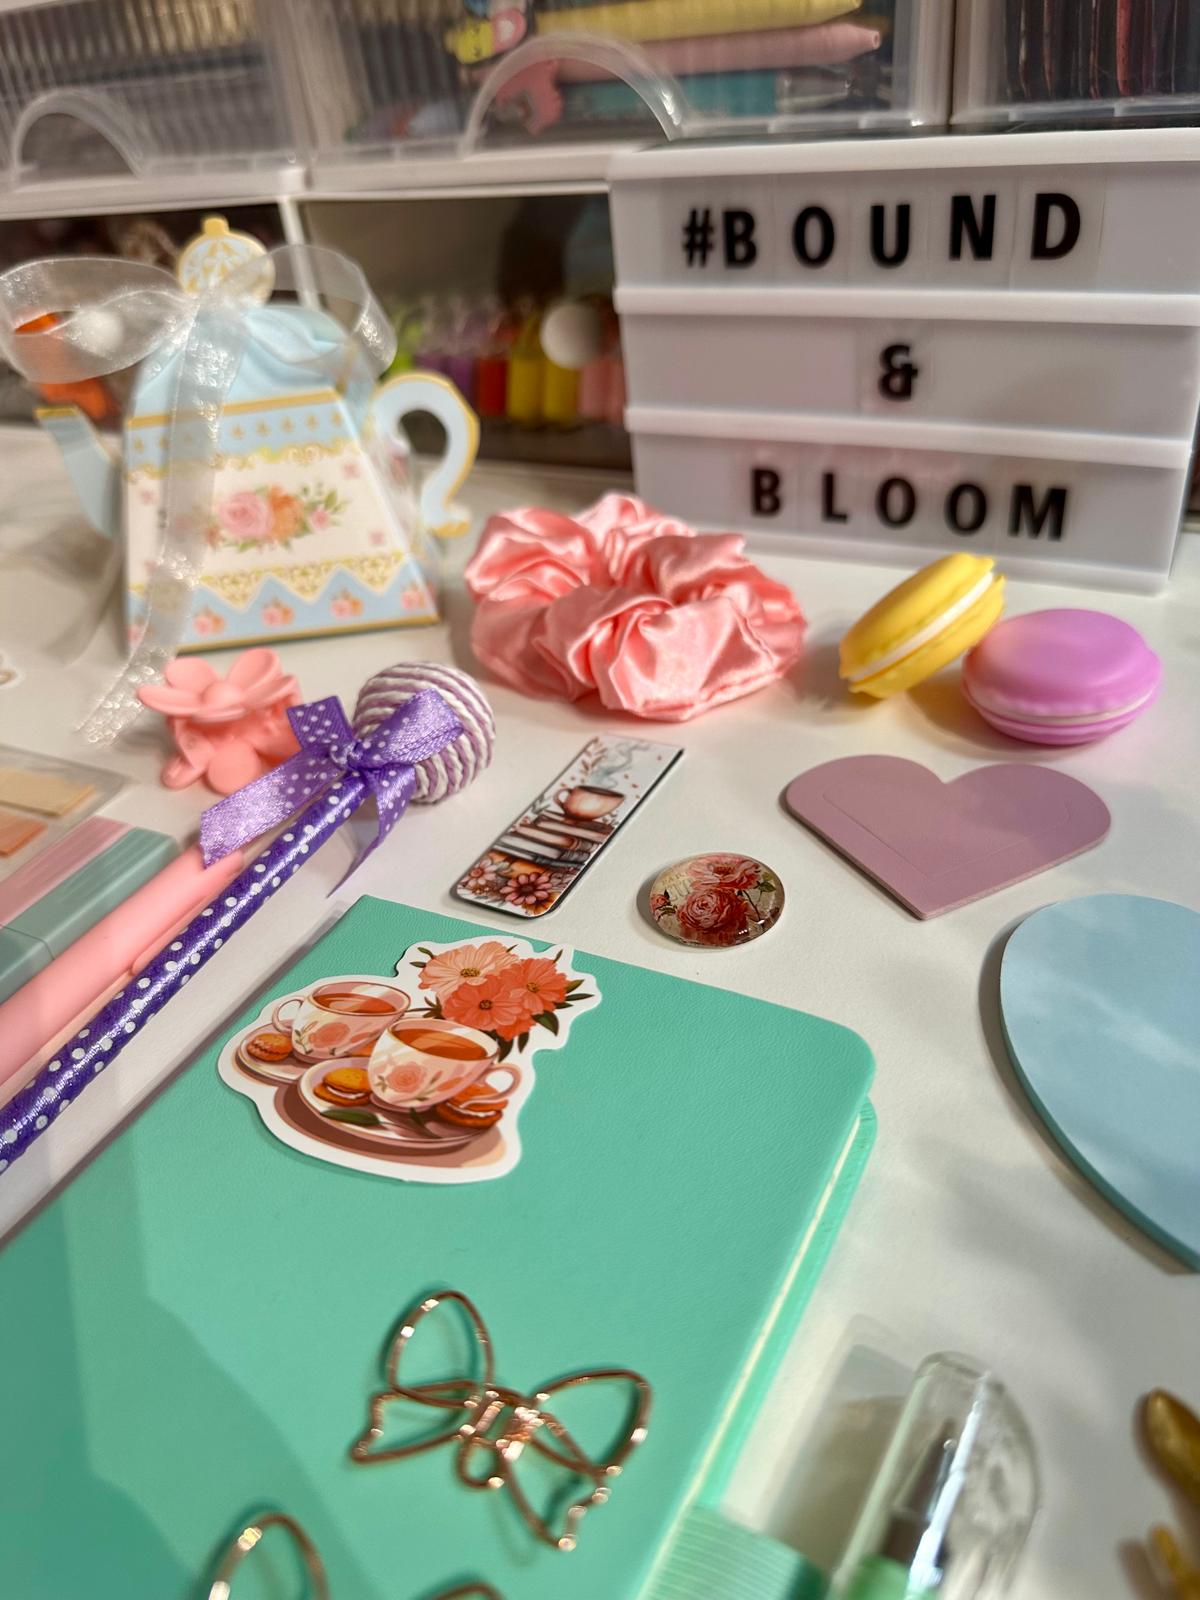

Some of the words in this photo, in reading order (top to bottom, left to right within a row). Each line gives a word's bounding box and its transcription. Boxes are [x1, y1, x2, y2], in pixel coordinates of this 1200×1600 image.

[681, 191, 1082, 270] #BOUND
[876, 341, 920, 402] &
[750, 465, 1071, 541] BLOOM
